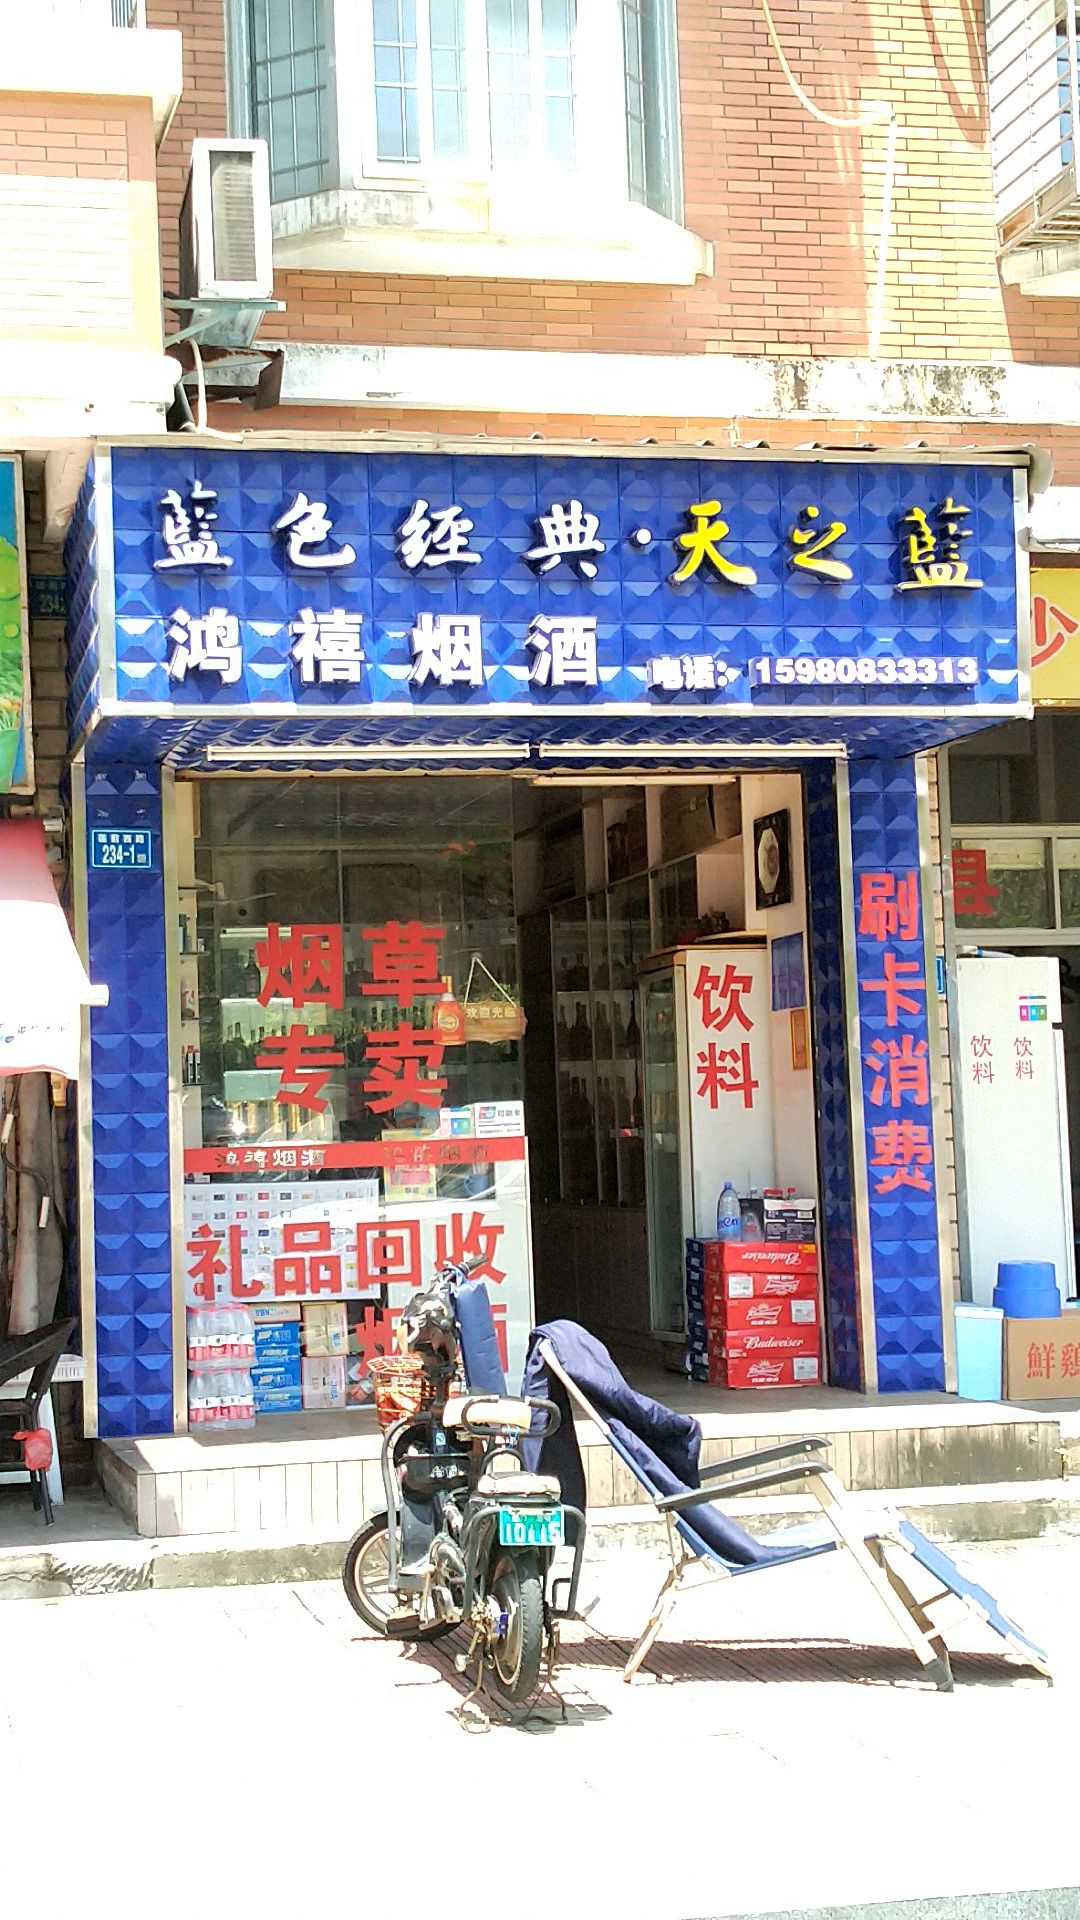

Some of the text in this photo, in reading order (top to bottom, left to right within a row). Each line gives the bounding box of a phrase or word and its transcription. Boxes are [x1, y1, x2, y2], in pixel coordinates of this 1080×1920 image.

[165, 607, 604, 688] 鸿禧烟酒
[755, 657, 978, 685] 15980833313
[255, 920, 446, 1009] 烟草
[255, 1023, 448, 1114] 专卖
[693, 963, 760, 1110] 饮料
[858, 871, 933, 1195] 刷卡消费
[969, 1034, 995, 1085] 饮料
[1013, 1036, 1034, 1080] 饮料
[187, 1211, 505, 1301] 礼品回收
[743, 1336, 804, 1350] Budweiser
